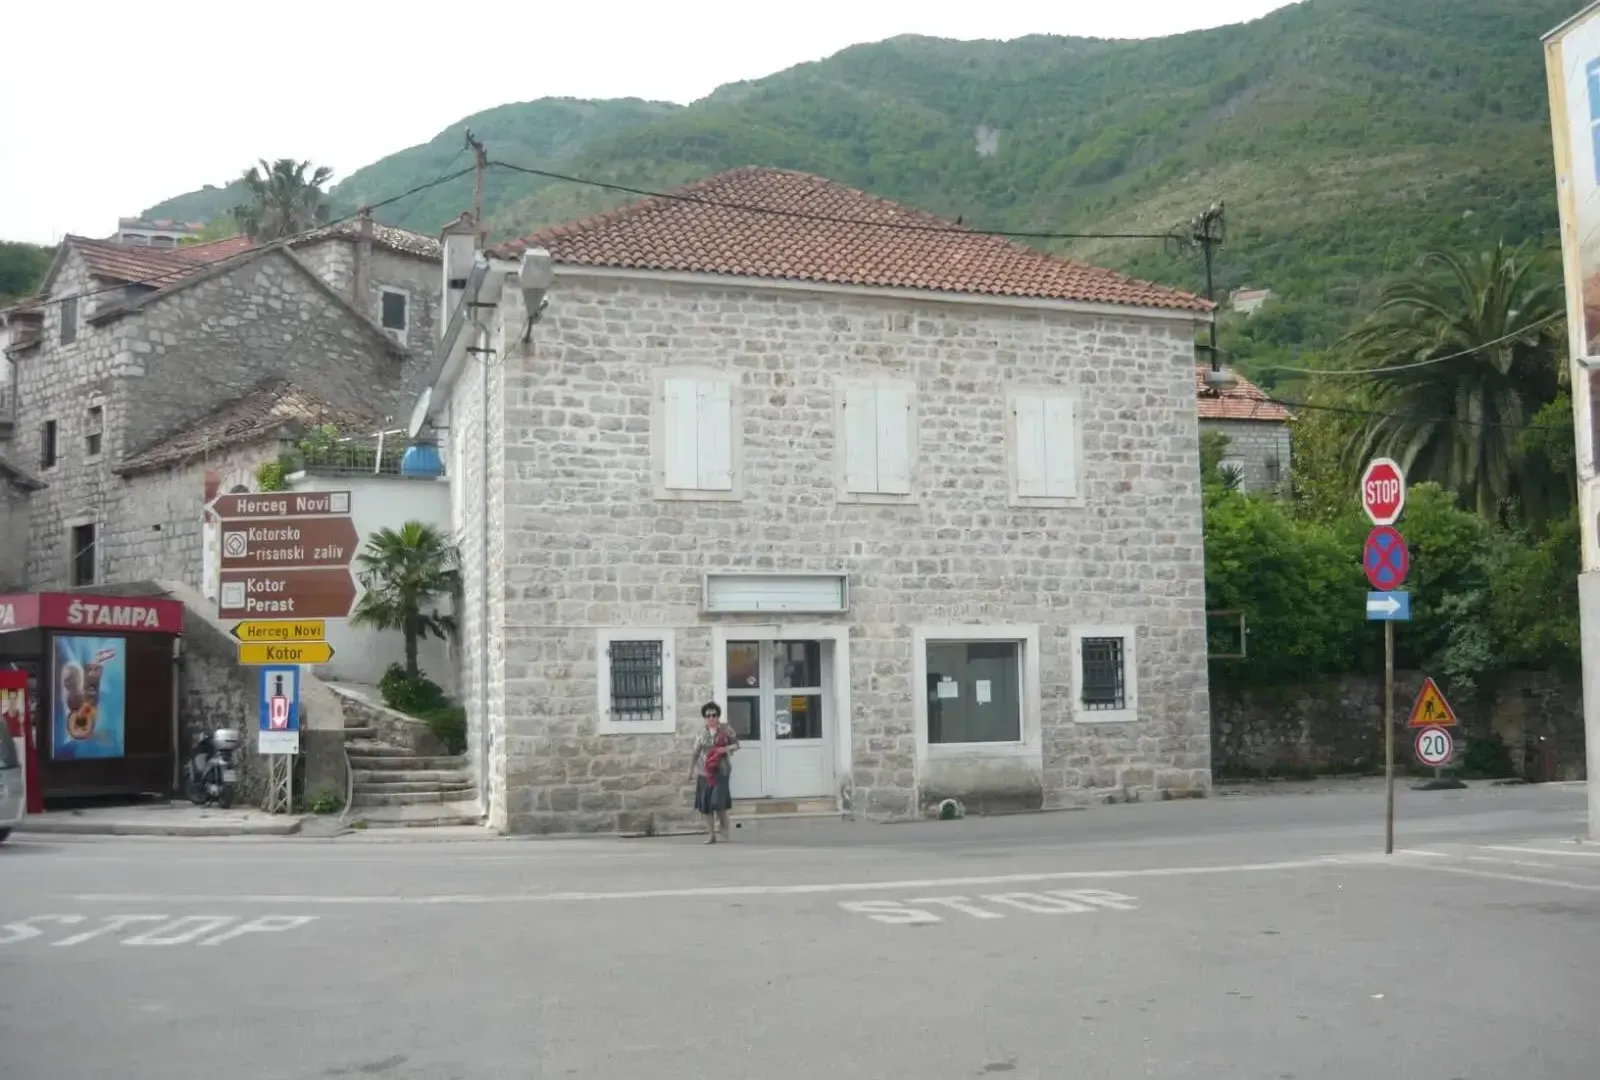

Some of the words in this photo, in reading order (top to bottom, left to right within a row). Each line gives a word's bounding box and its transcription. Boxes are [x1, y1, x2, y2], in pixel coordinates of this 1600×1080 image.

[1366, 480, 1398, 504] STOP
[237, 499, 287, 515] Herceg
[296, 496, 329, 511] Novi
[249, 526, 300, 541] Kotorsko
[313, 545, 344, 559] zaliv
[247, 578, 286, 593] Kotor
[246, 598, 294, 612] Perast
[67, 600, 159, 627] ŠTAMPA
[247, 627, 289, 639] Herceg
[294, 625, 321, 637] Novi
[266, 645, 303, 660] Kotor
[1423, 735, 1446, 755] 20
[838, 888, 1138, 924] STOP
